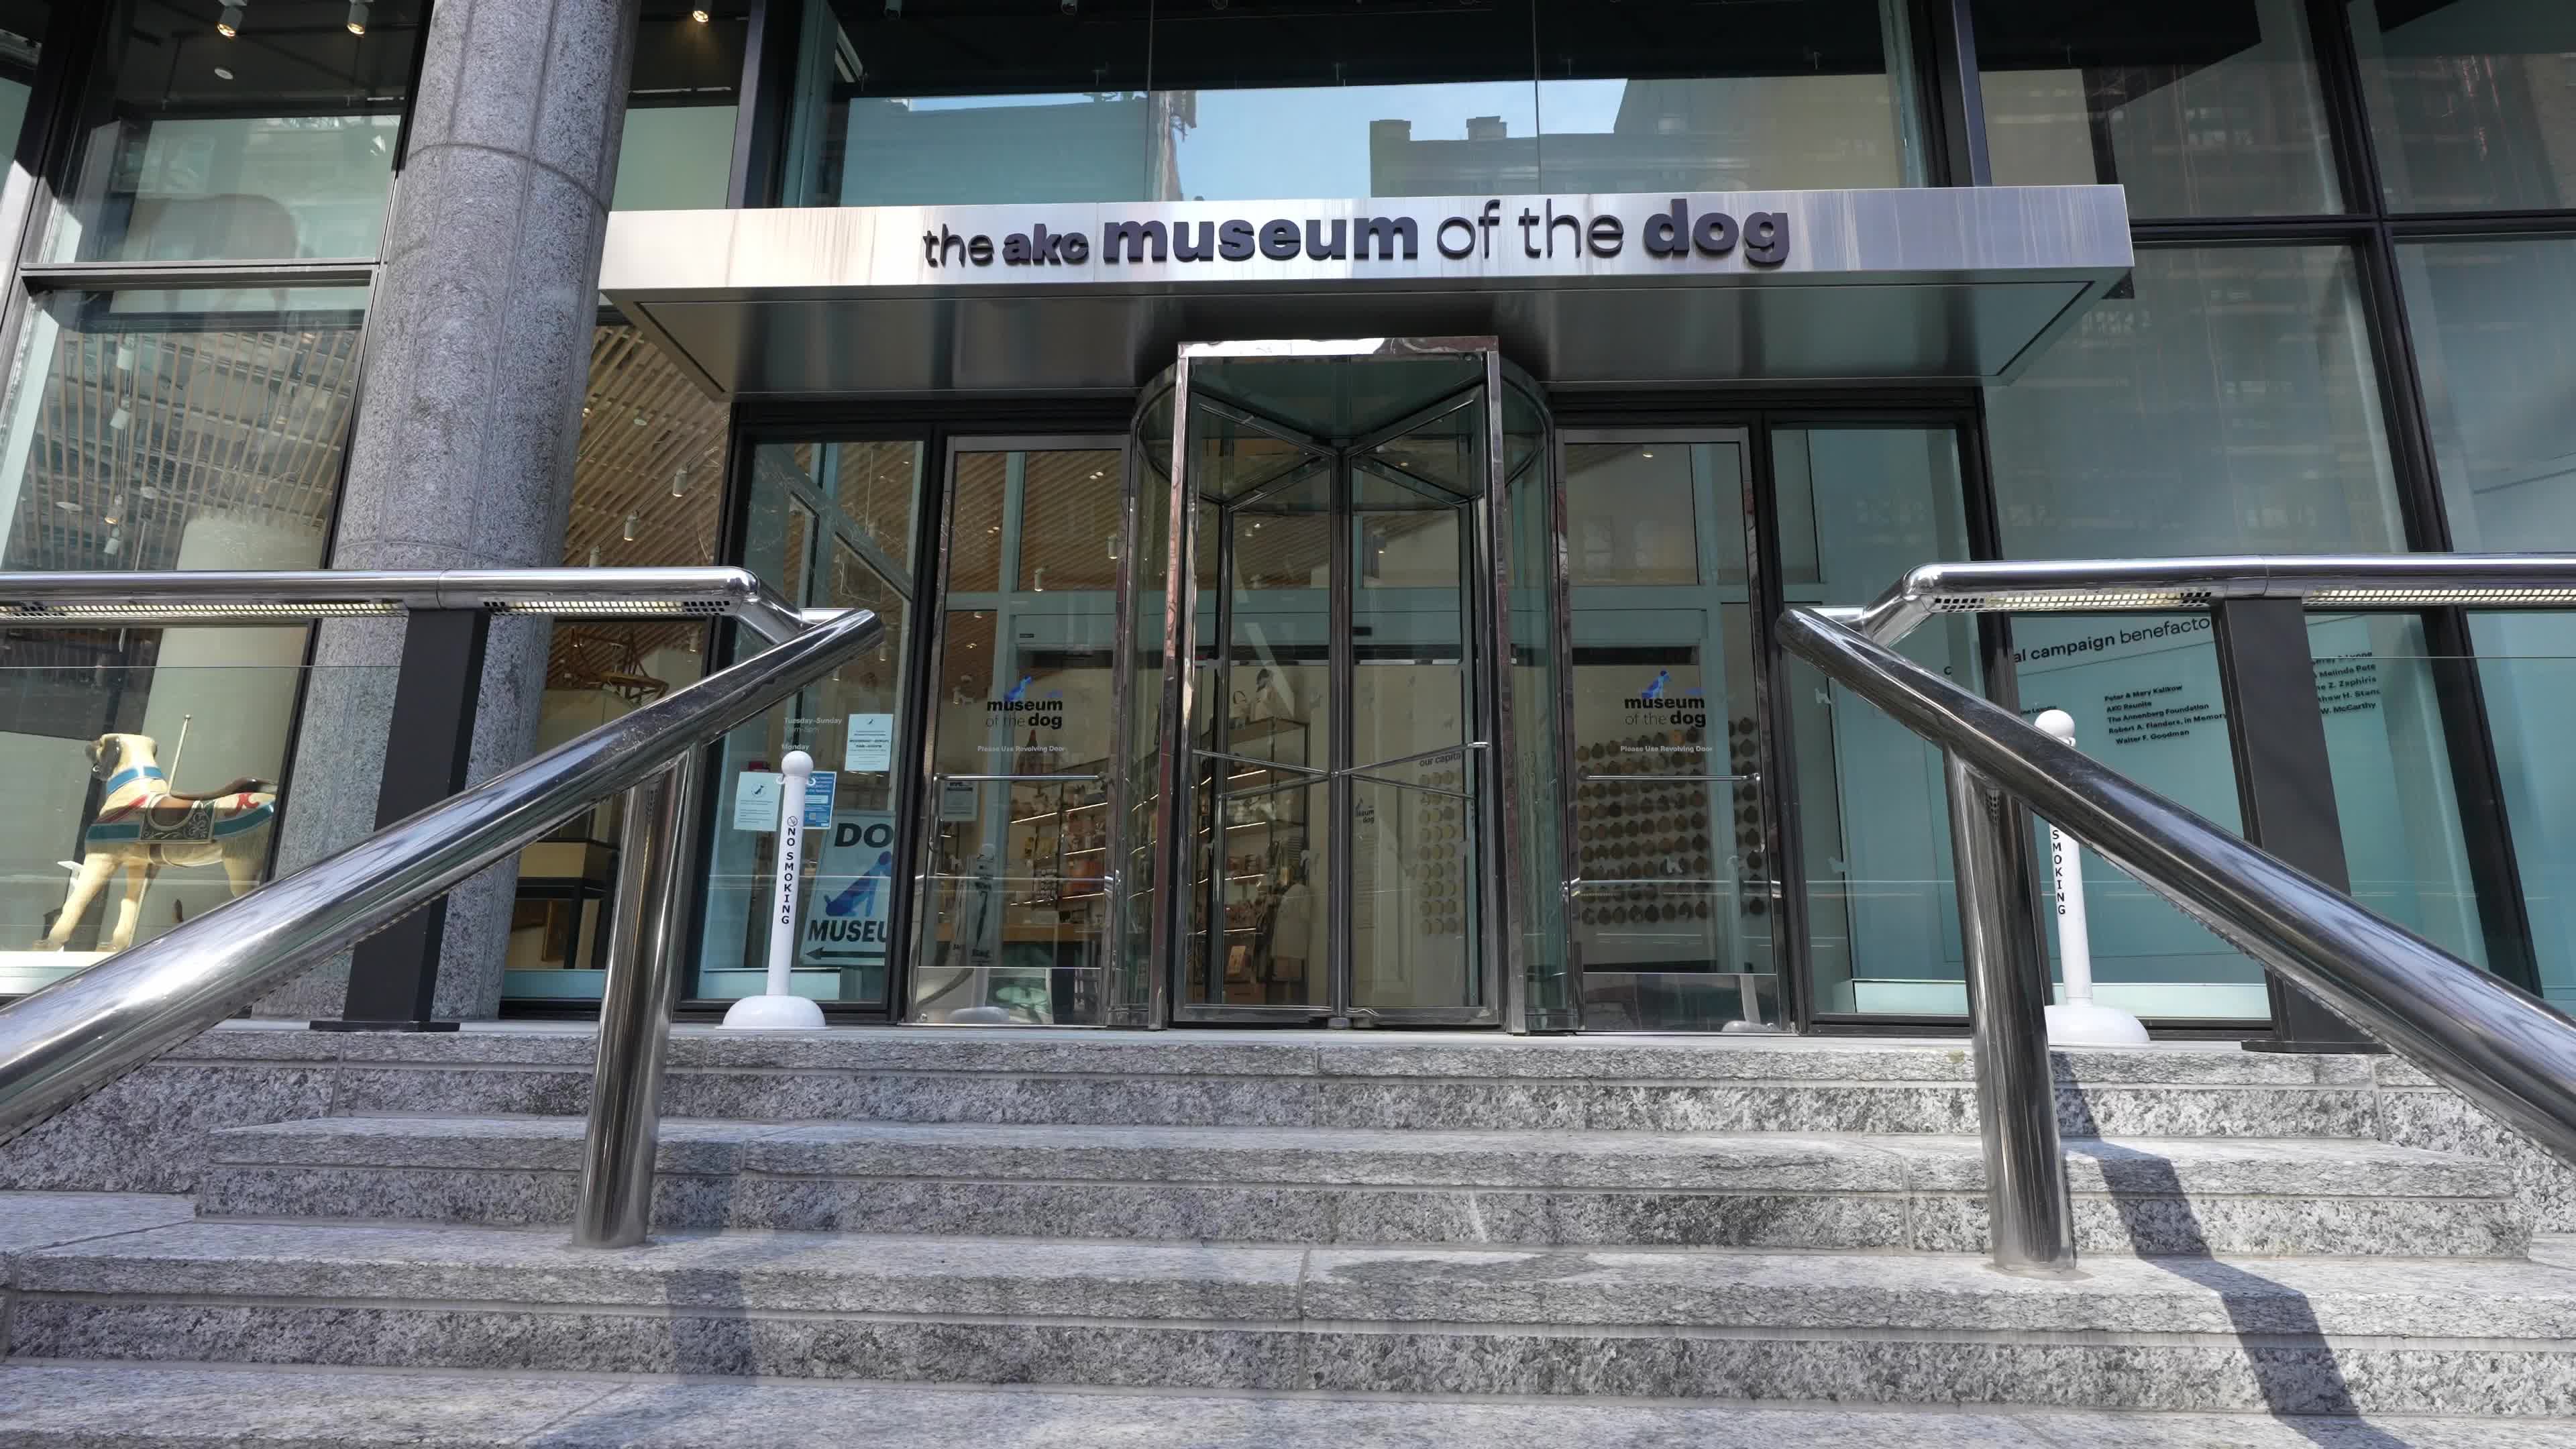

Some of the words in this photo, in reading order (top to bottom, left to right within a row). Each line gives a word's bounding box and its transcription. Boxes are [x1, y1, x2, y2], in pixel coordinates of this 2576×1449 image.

[922, 223, 994, 268] the
[1002, 223, 1089, 266] akc
[1103, 216, 1419, 263] museum
[1436, 199, 1501, 259] of
[1518, 199, 1624, 259] the
[1643, 198, 1790, 265] dog
[2031, 634, 2115, 660] campaign
[2120, 616, 2210, 644] benefacto
[2133, 689, 2152, 699] Mary
[2153, 684, 2183, 694] Kalikow
[987, 700, 1063, 712] museum
[1624, 697, 1705, 709] museum
[2333, 702, 2376, 713] McCarthy
[1003, 713, 1026, 727] the
[1028, 712, 1063, 730] dog
[1625, 712, 1640, 725] of
[1643, 712, 1667, 725] the
[1670, 710, 1706, 728] dog
[2108, 716, 2121, 724] The
[2123, 709, 2164, 722] Annenberg
[2165, 703, 2209, 715] Foundation
[2108, 724, 2135, 735] Robert
[2151, 729, 2190, 740] Goodman
[1015, 745, 1047, 753] Revolving
[1660, 745, 1695, 753] Revolving
[786, 827, 796, 847] NO
[834, 822, 894, 848] DO
[2051, 829, 2066, 915] SMOKING
[782, 852, 794, 925] SMOKING
